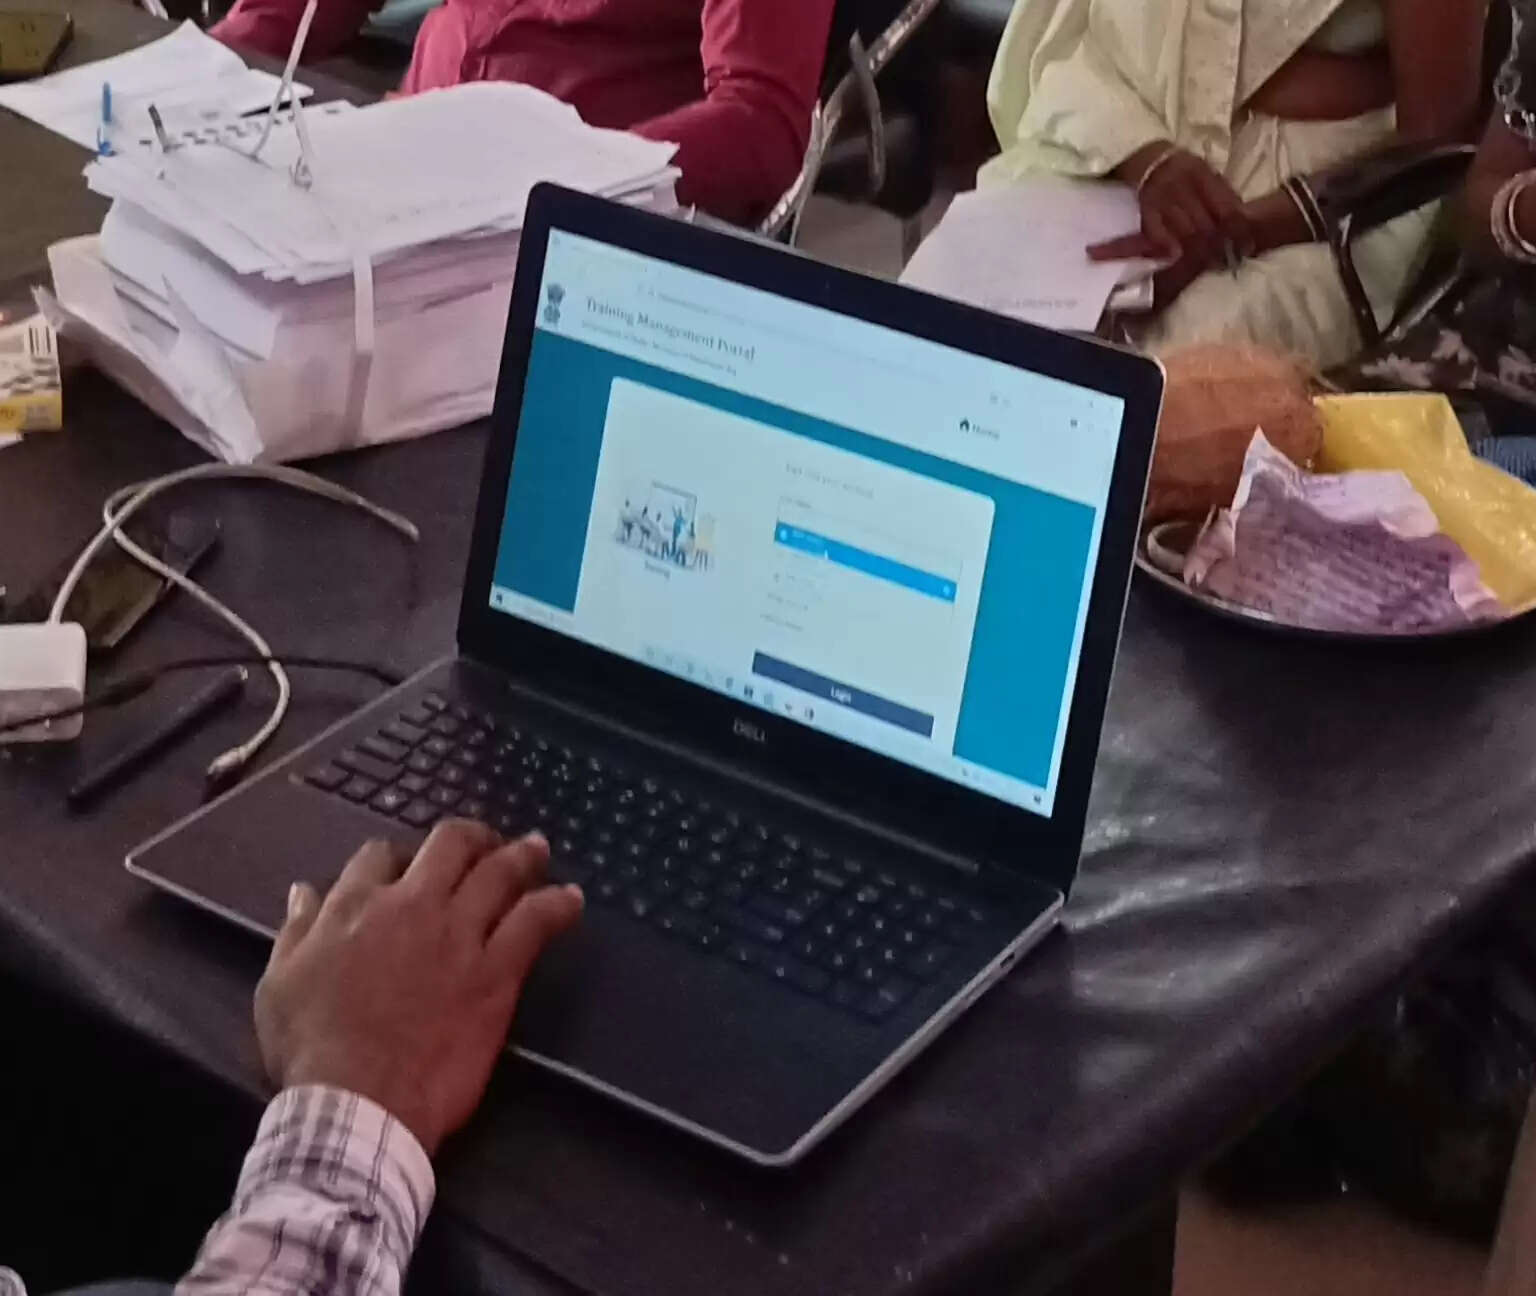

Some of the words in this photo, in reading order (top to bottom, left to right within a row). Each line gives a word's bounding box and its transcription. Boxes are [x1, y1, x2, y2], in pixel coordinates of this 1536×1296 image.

[586, 296, 635, 326] Training
[637, 311, 714, 349] Management
[717, 338, 756, 362] Portal
